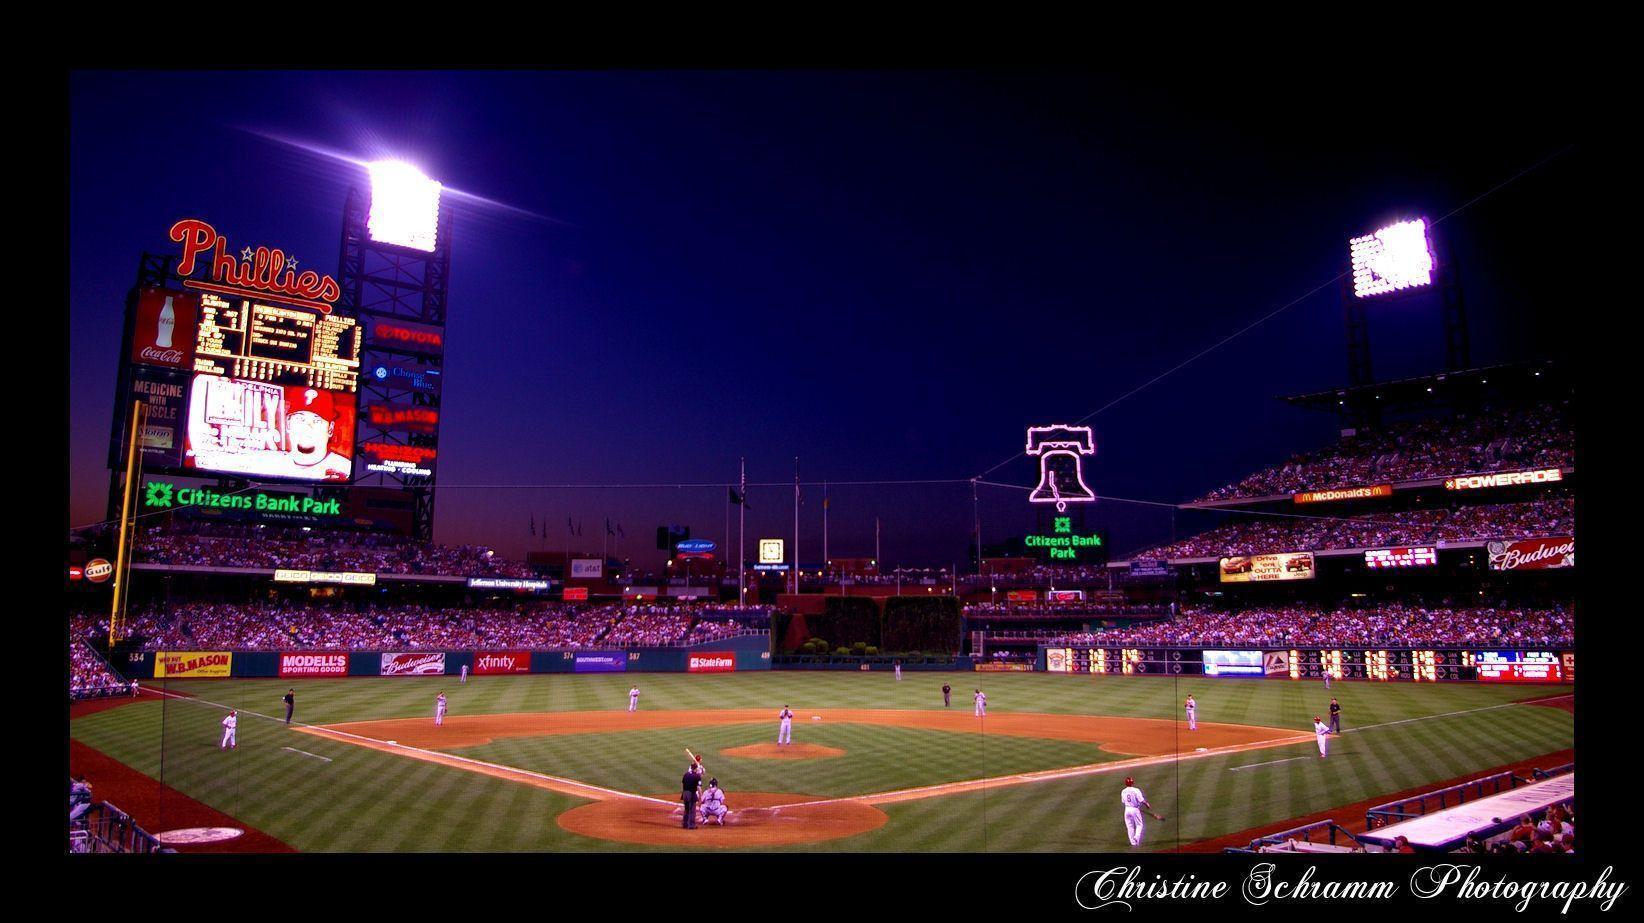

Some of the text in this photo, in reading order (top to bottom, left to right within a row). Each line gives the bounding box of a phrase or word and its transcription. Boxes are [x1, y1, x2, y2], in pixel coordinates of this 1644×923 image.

[170, 219, 340, 302] Phillies
[392, 327, 442, 345] TOYOTA
[140, 403, 177, 419] USCLE
[1455, 470, 1561, 490] POWERADE
[177, 488, 341, 515] Citizens Bank Park
[1312, 489, 1372, 501] McDonald's
[1025, 535, 1102, 546] Citizens Bank
[1050, 548, 1076, 558] Park
[86, 564, 112, 576] Gulf
[283, 656, 346, 667] MODELL'S
[386, 653, 444, 674] Budweiser
[478, 654, 516, 670] xfinity
[283, 666, 319, 674] SPORTING
